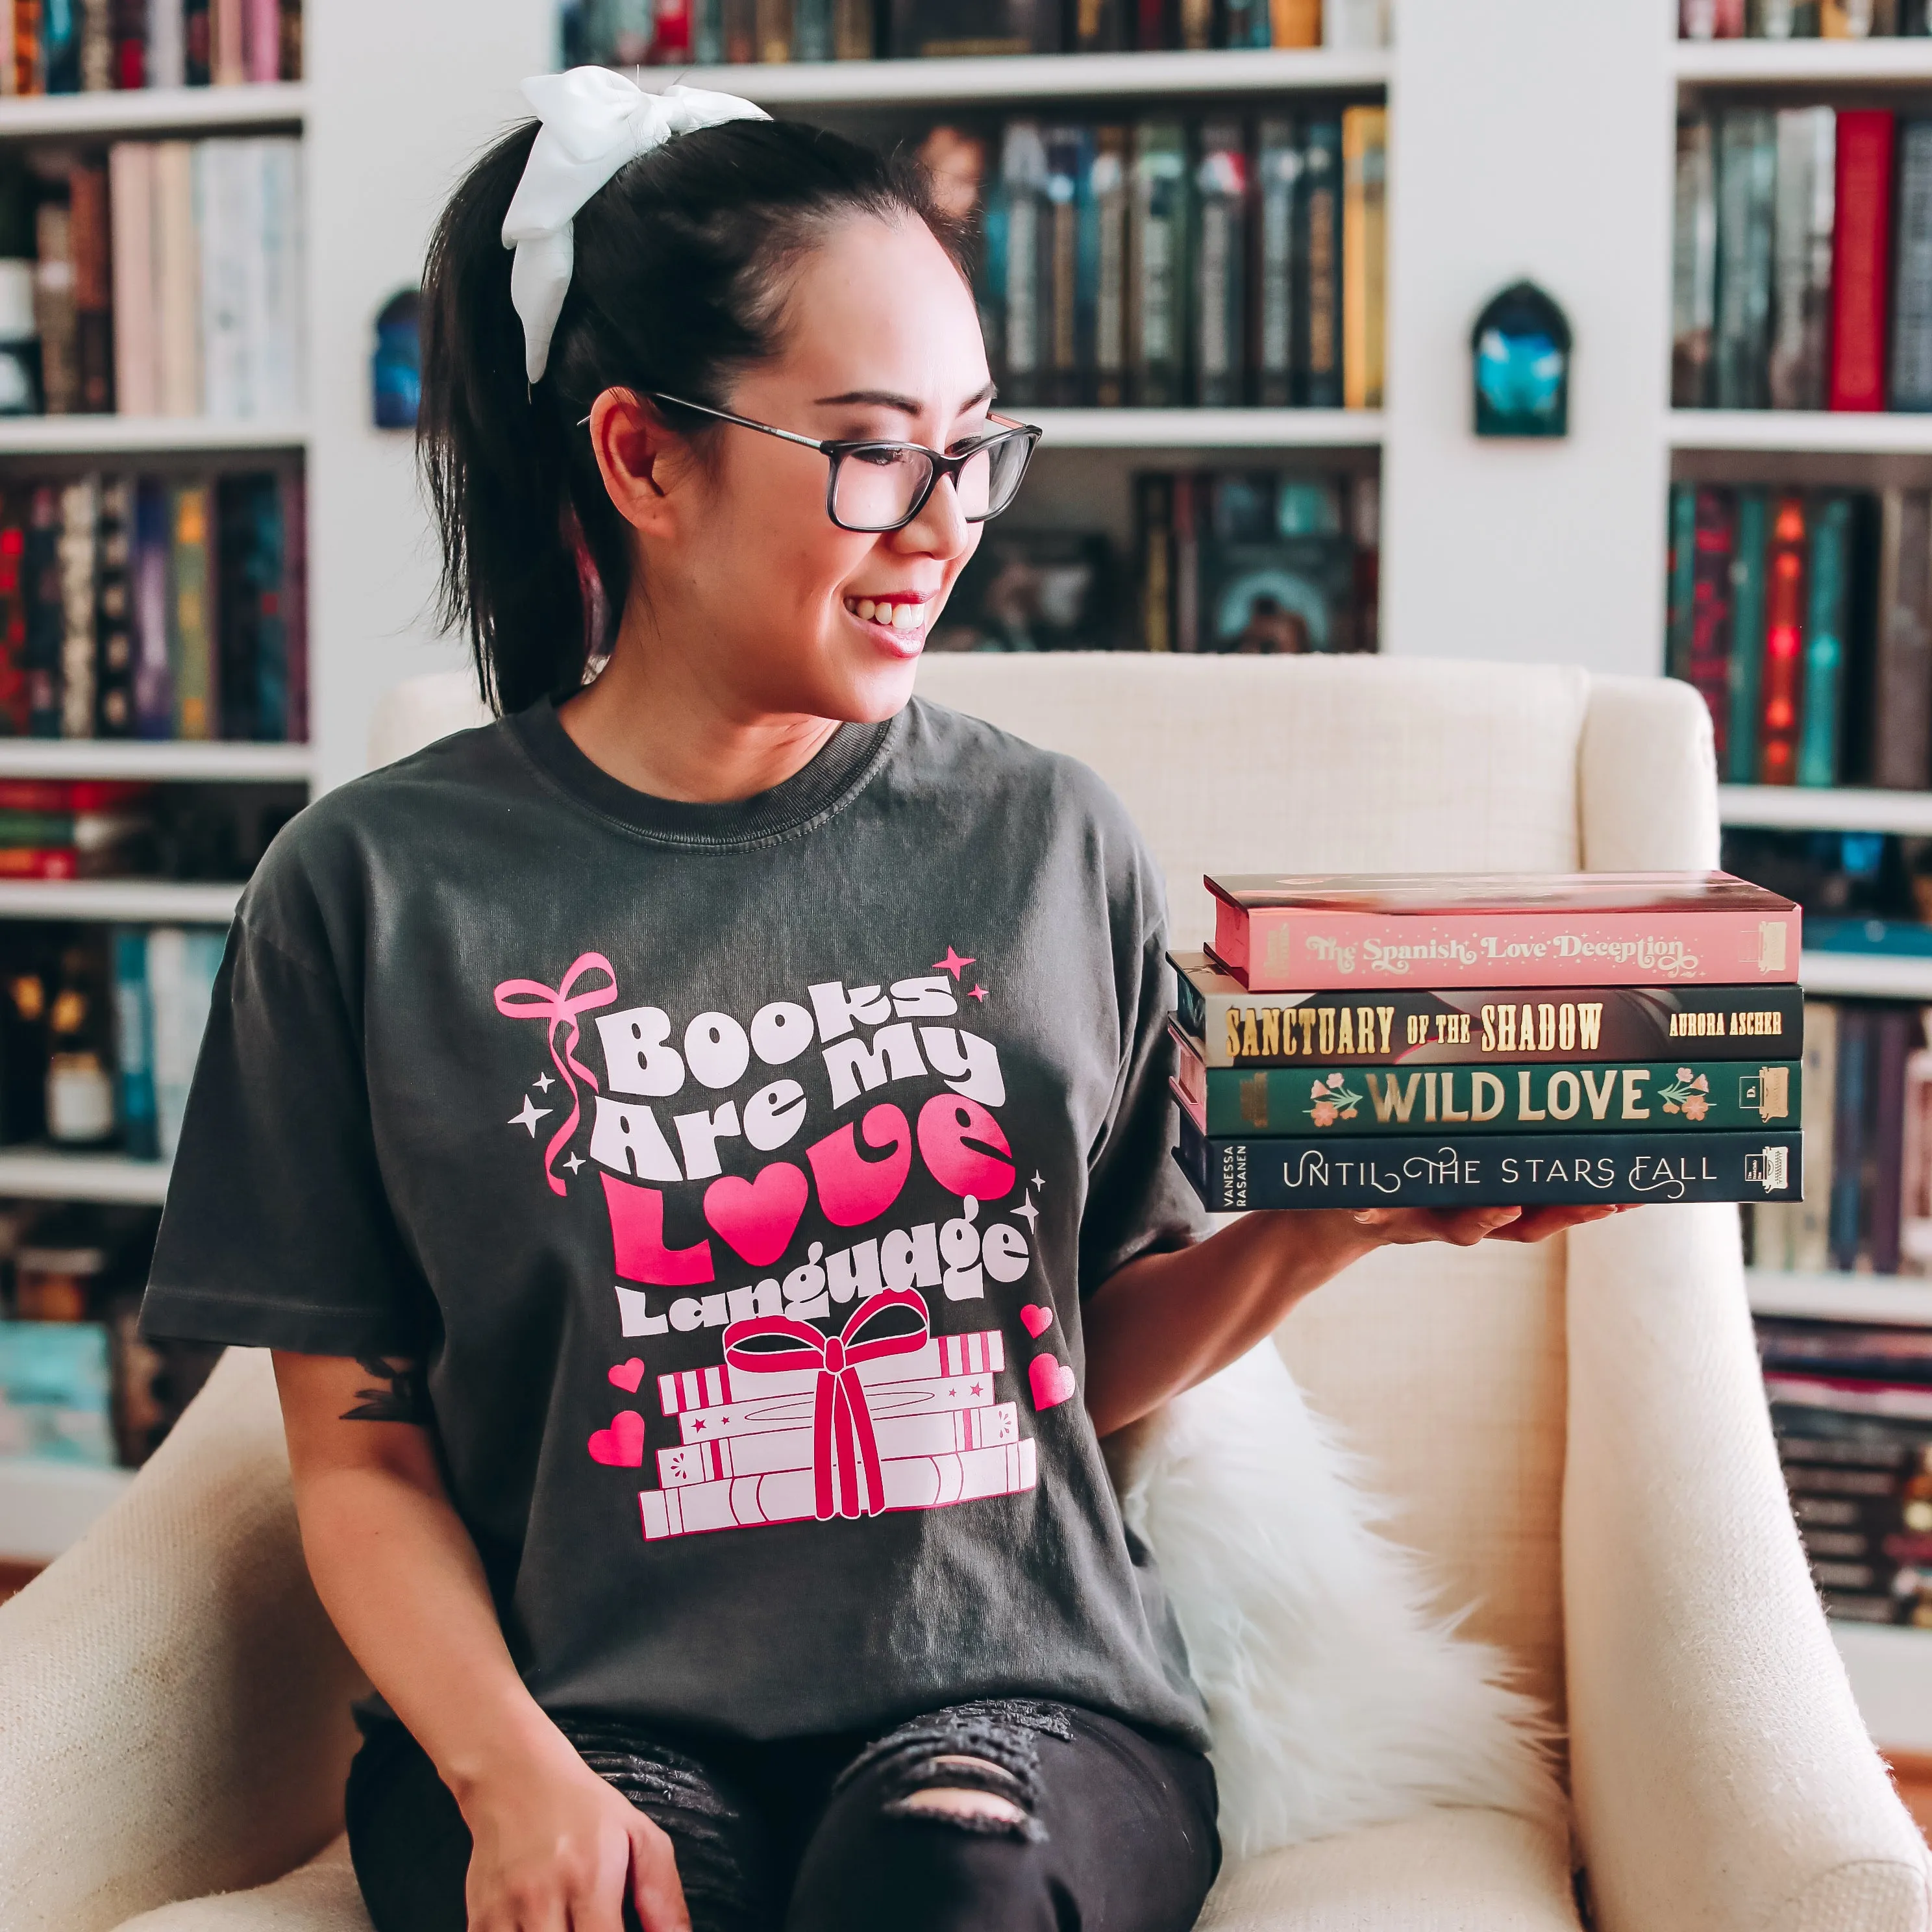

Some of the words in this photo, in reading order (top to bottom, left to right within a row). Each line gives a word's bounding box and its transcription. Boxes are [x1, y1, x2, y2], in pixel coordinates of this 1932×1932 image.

[1306, 935, 1358, 974] The
[1363, 937, 1477, 974] Spanish
[1481, 936, 1546, 958] Love
[1553, 935, 1698, 976] Deception
[595, 976, 958, 1097] Books
[1226, 1006, 1394, 1057] SANCTUARY
[1407, 1015, 1429, 1044] OF
[1435, 1014, 1470, 1044] THE
[1481, 1003, 1603, 1052] SHADOW
[1669, 1012, 1725, 1037] AURORA
[1729, 1011, 1782, 1036] ASCHER
[589, 1079, 807, 1182] Are
[821, 1022, 1006, 1107] My
[1365, 1072, 1505, 1123] WILD
[1518, 1070, 1650, 1121] LOVE
[1223, 1146, 1233, 1207] VANESSA
[1236, 1146, 1246, 1207] RASANEN
[1283, 1150, 1401, 1193] UNTIL
[1404, 1146, 1480, 1184] THE
[1502, 1158, 1615, 1189] STARS
[1629, 1156, 1717, 1199] FALL
[614, 1195, 1030, 1337] Language
